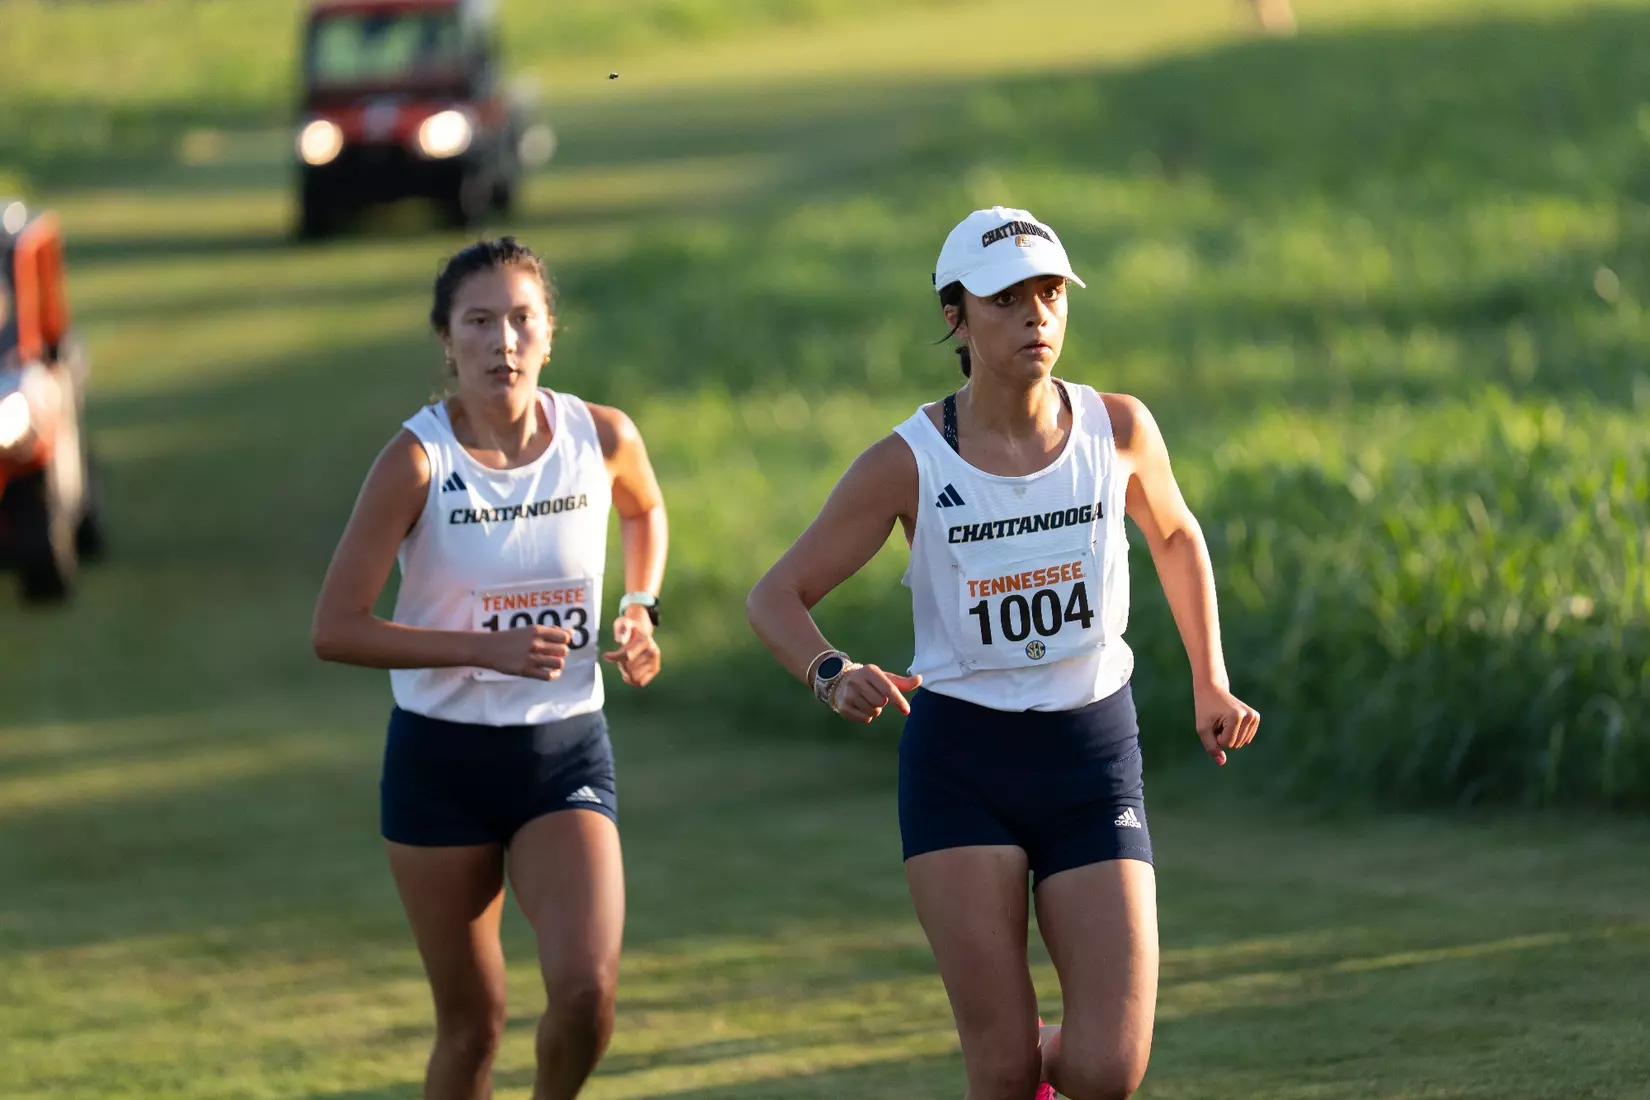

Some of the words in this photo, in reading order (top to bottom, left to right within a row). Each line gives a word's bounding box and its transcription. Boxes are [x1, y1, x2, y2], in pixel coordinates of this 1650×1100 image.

[449, 494, 588, 524] CHATTANOOGA
[949, 502, 1104, 544] CHATTANOOGA
[967, 561, 1084, 598] TENNESSEE
[482, 587, 585, 611] TENNESSEE
[969, 581, 1095, 645] 1004
